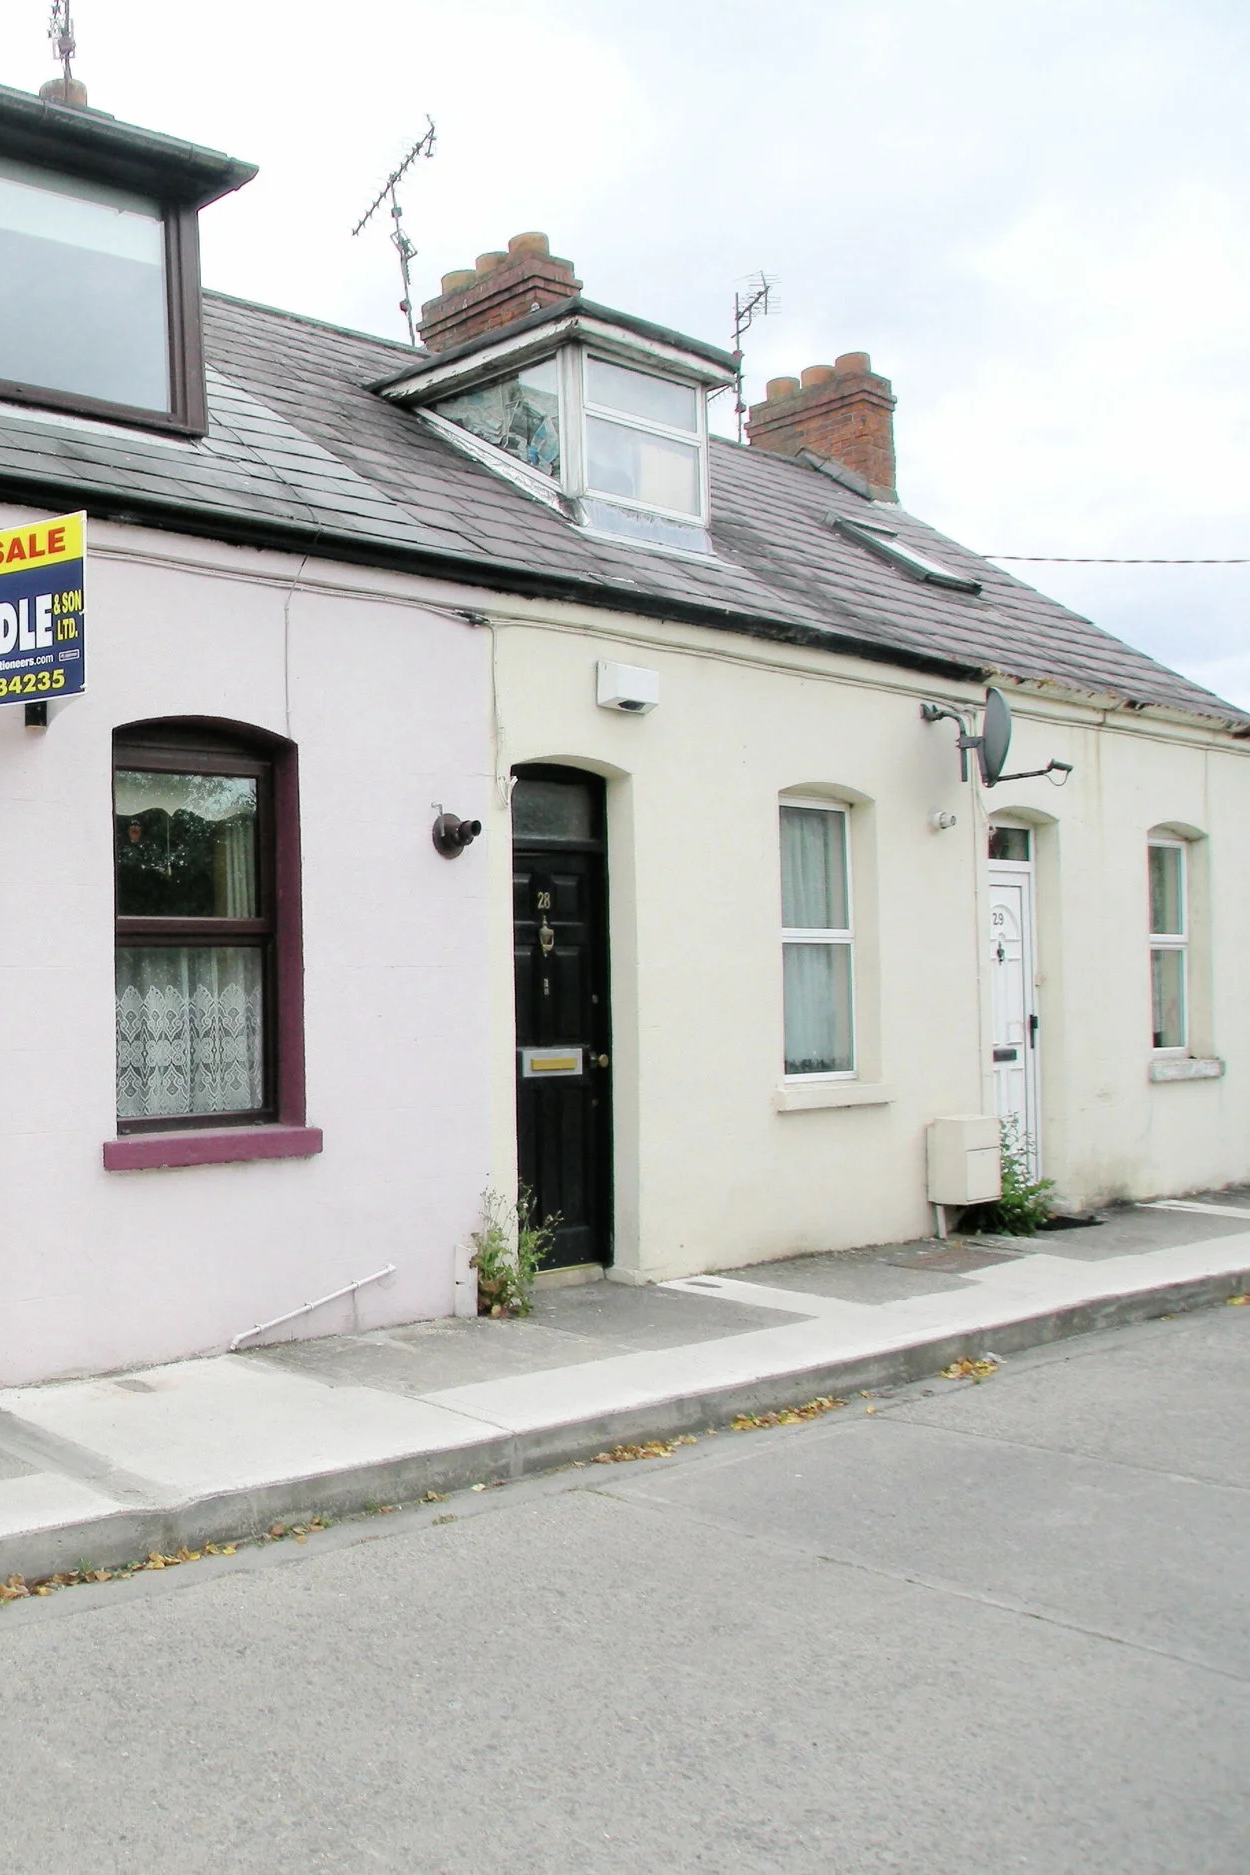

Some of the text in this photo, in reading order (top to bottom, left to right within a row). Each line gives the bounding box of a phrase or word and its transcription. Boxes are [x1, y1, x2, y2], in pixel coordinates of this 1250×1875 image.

[53, 593, 61, 615] &
[61, 589, 82, 614] SON
[57, 617, 79, 641] LTD.
[537, 891, 551, 910] 28
[992, 912, 1004, 926] 29
